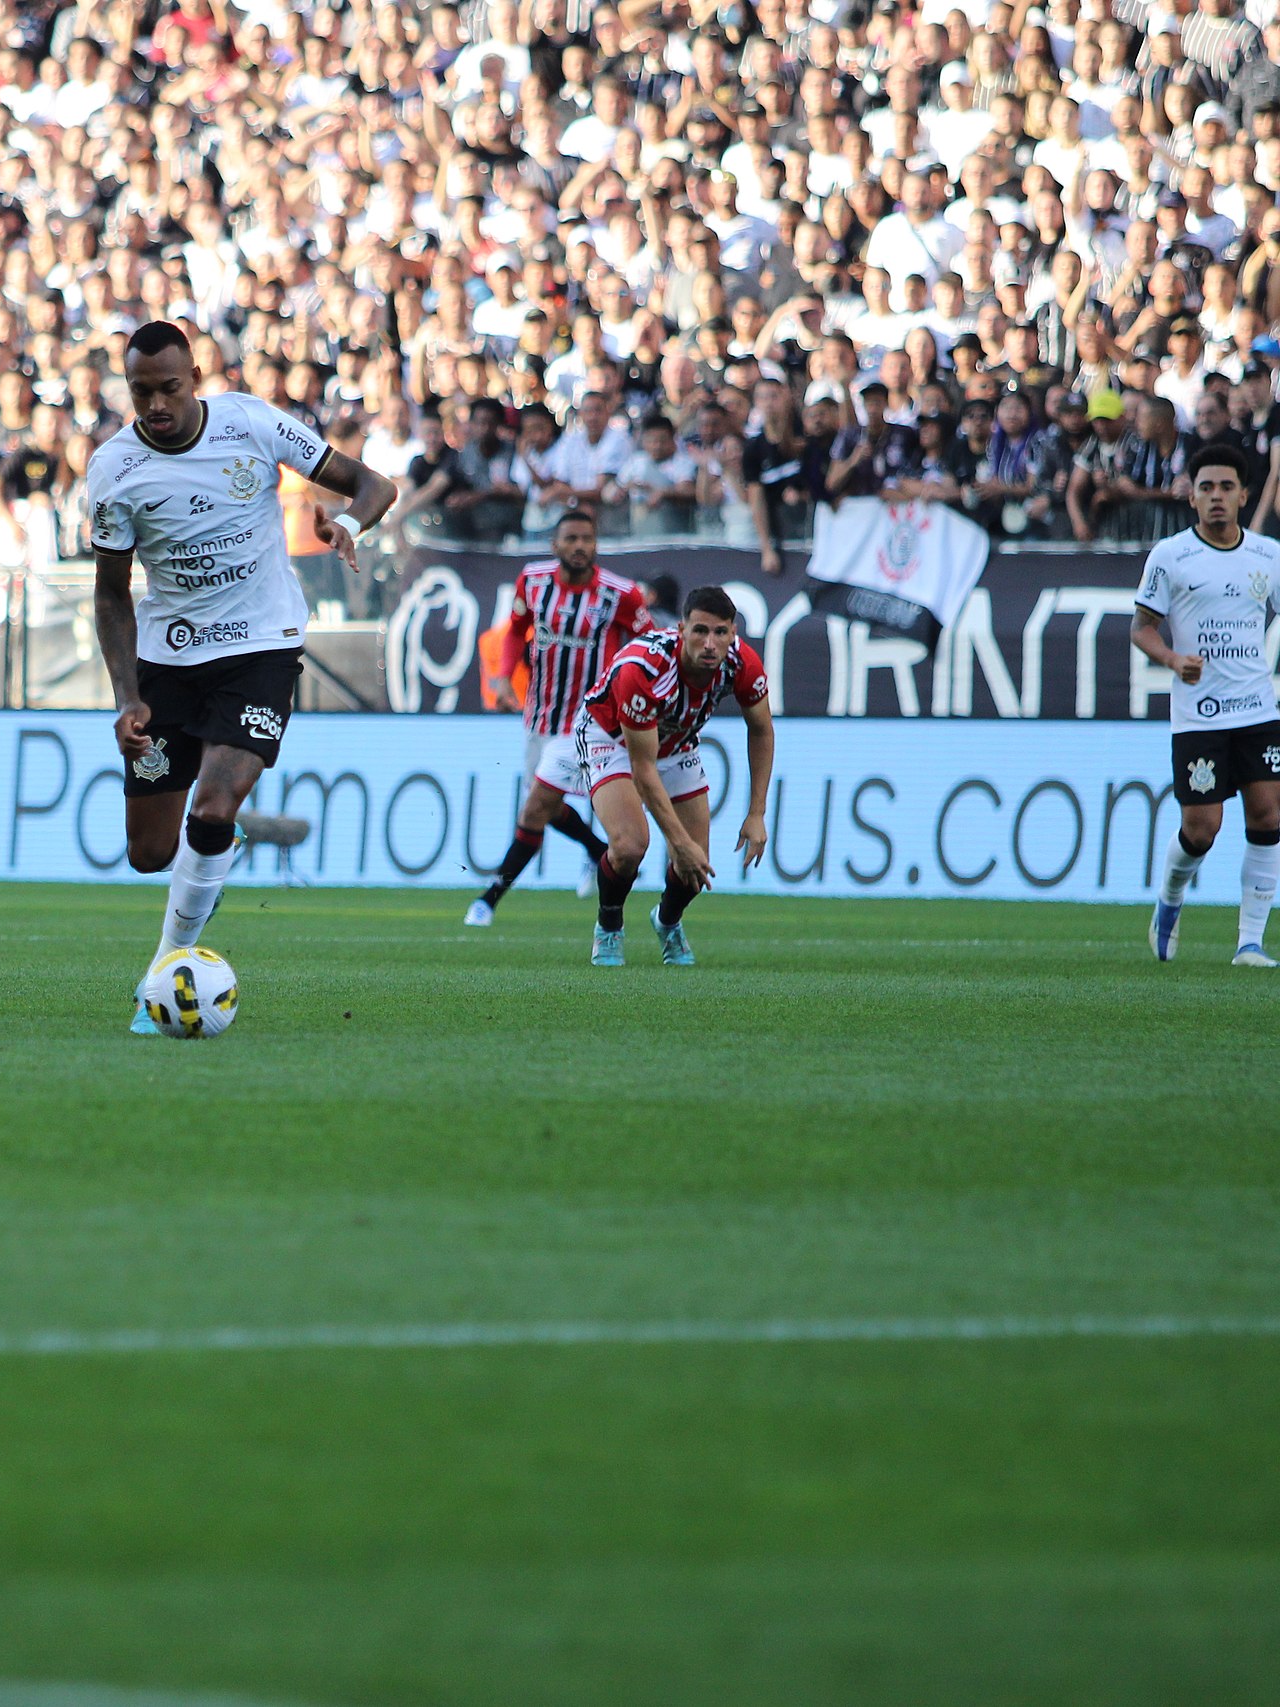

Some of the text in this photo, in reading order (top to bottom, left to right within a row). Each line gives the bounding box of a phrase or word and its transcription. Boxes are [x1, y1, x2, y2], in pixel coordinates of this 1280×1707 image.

[209, 432, 250, 444] galera.bet
[285, 427, 318, 460] bmg
[114, 454, 153, 483] galera.bet
[95, 501, 108, 531] bmg
[189, 503, 215, 516] ALE
[167, 529, 253, 557] vitaminas
[170, 556, 216, 571] neo
[175, 560, 257, 592] química
[1197, 618, 1259, 630] vitaminas
[192, 631, 249, 646] BITCOIN
[1198, 631, 1232, 645] neo
[1198, 646, 1260, 662] química
[245, 705, 275, 718] Cartão
[240, 713, 283, 741] TODOS
